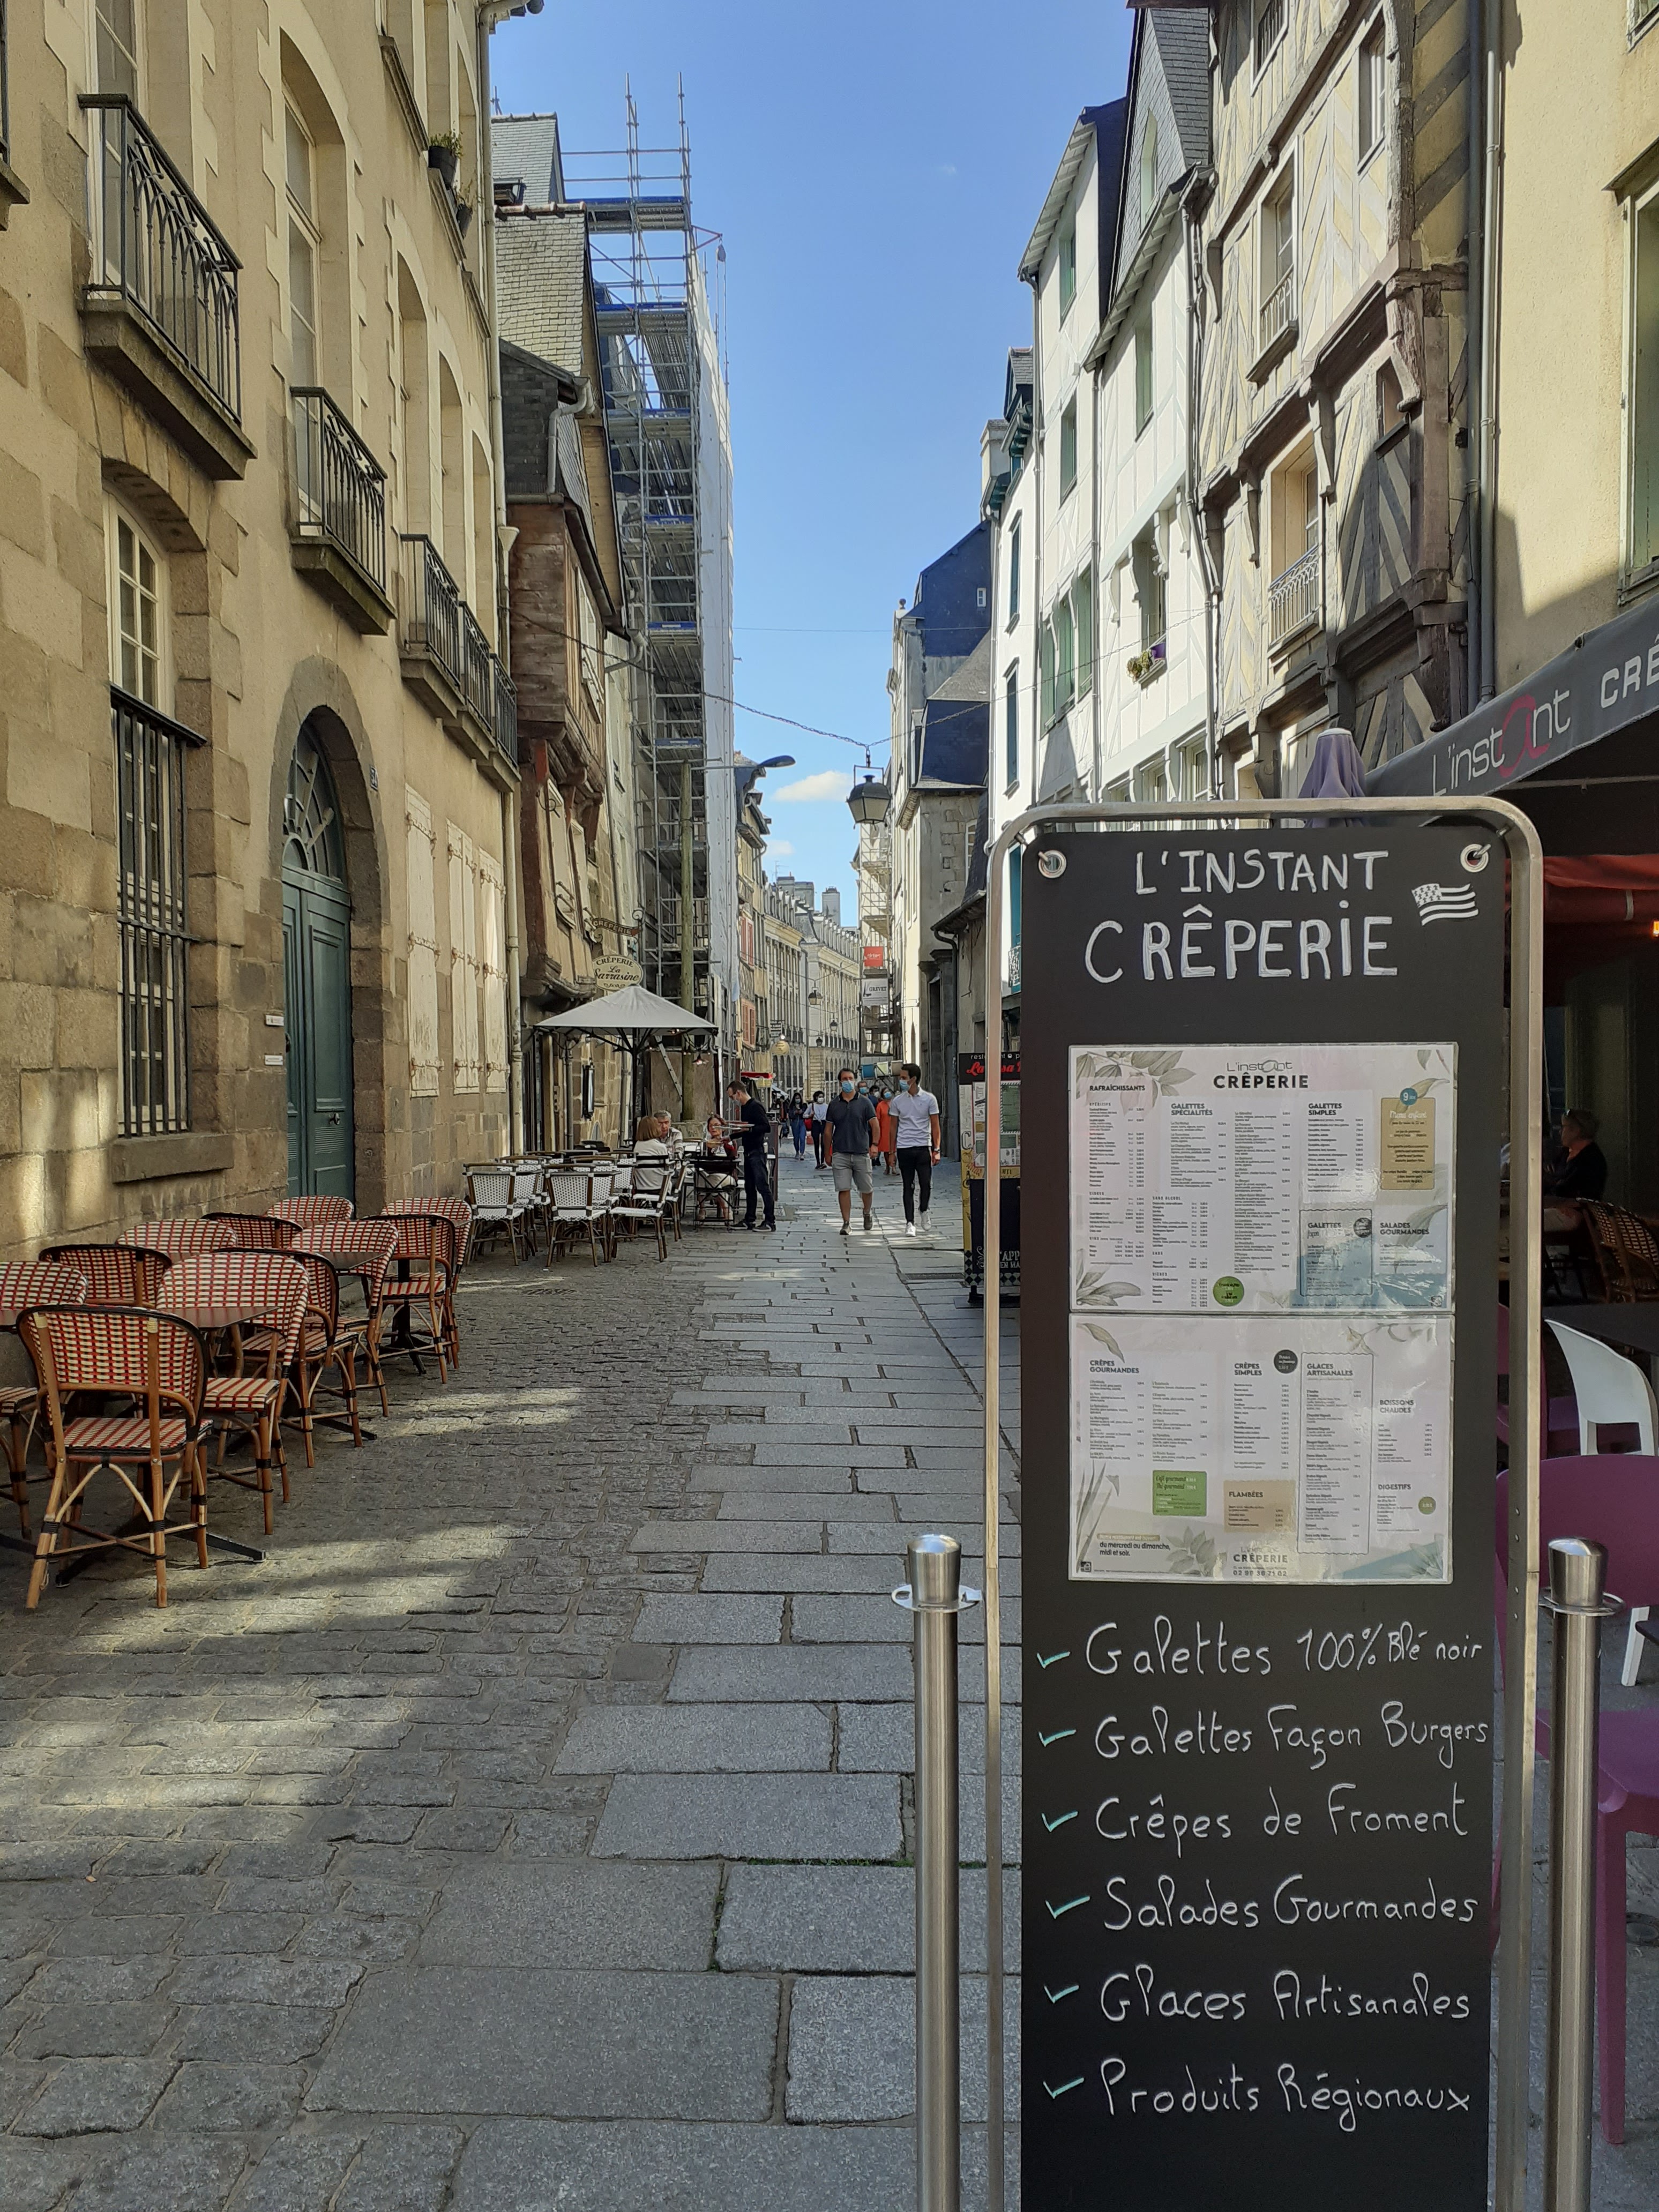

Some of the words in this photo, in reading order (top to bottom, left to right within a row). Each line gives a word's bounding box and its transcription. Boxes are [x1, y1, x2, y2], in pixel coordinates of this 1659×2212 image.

[1135, 848, 1389, 894] L'INSTANT
[595, 968, 639, 981] Sarrasine
[596, 956, 634, 967] CRÊPERIE
[608, 965, 621, 973] La
[1213, 1072, 1309, 1089] CRÊPERIE
[1228, 1490, 1264, 1498] FLAMBÉES
[1141, 1543, 1171, 1551] dimanche,
[1233, 1552, 1288, 1563] CRÊPERIE
[1086, 1615, 1272, 1675] Galettes
[1297, 1623, 1382, 1671] 100%
[1436, 1634, 1483, 1662] noir
[1094, 1706, 1252, 1759] Galettes
[1268, 1705, 1362, 1770] Façon
[1381, 1700, 1489, 1769] Burgers
[1096, 1794, 1232, 1858] Crêpes
[1264, 1786, 1303, 1835] de
[1328, 1782, 1468, 1836] Froment
[1104, 1874, 1259, 1930] Salades
[1274, 1874, 1479, 1925] Gourmandes
[1101, 1964, 1247, 2022] Glaces
[1274, 1970, 1470, 2021] Artisanales
[1101, 2058, 1260, 2116] Produits
[1278, 2063, 1469, 2132] Régionaux
